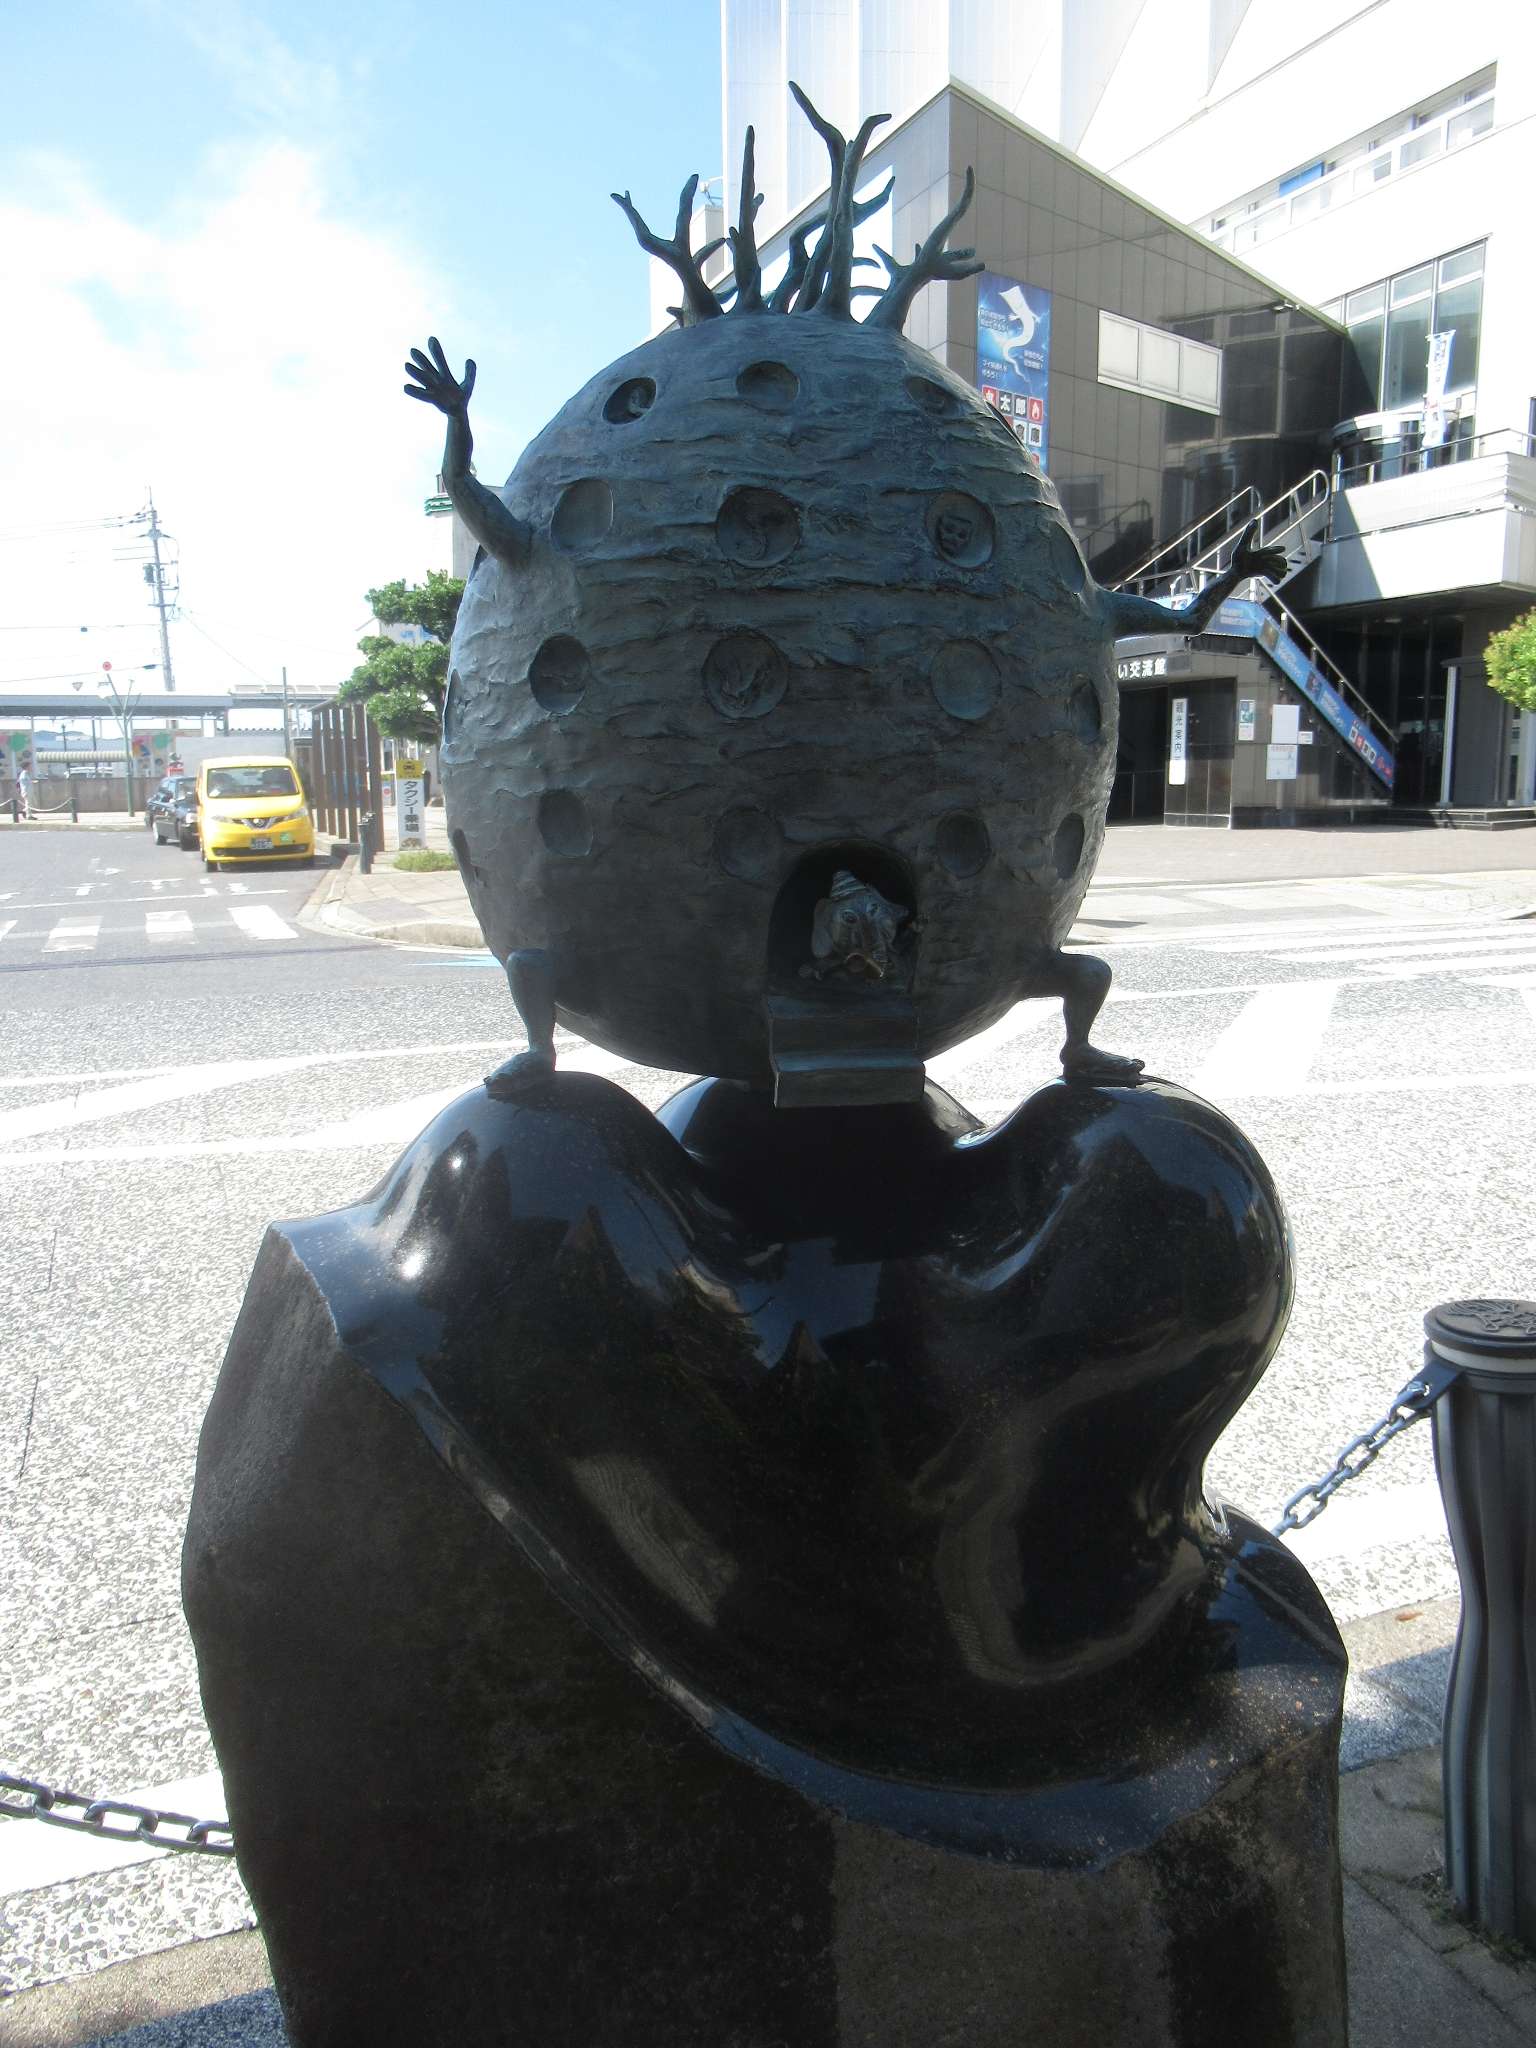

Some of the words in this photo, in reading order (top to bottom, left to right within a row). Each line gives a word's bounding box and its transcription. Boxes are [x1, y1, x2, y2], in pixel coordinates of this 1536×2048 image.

[1117, 657, 1166, 679] い交流館
[404, 781, 419, 833] タクシー乗場
